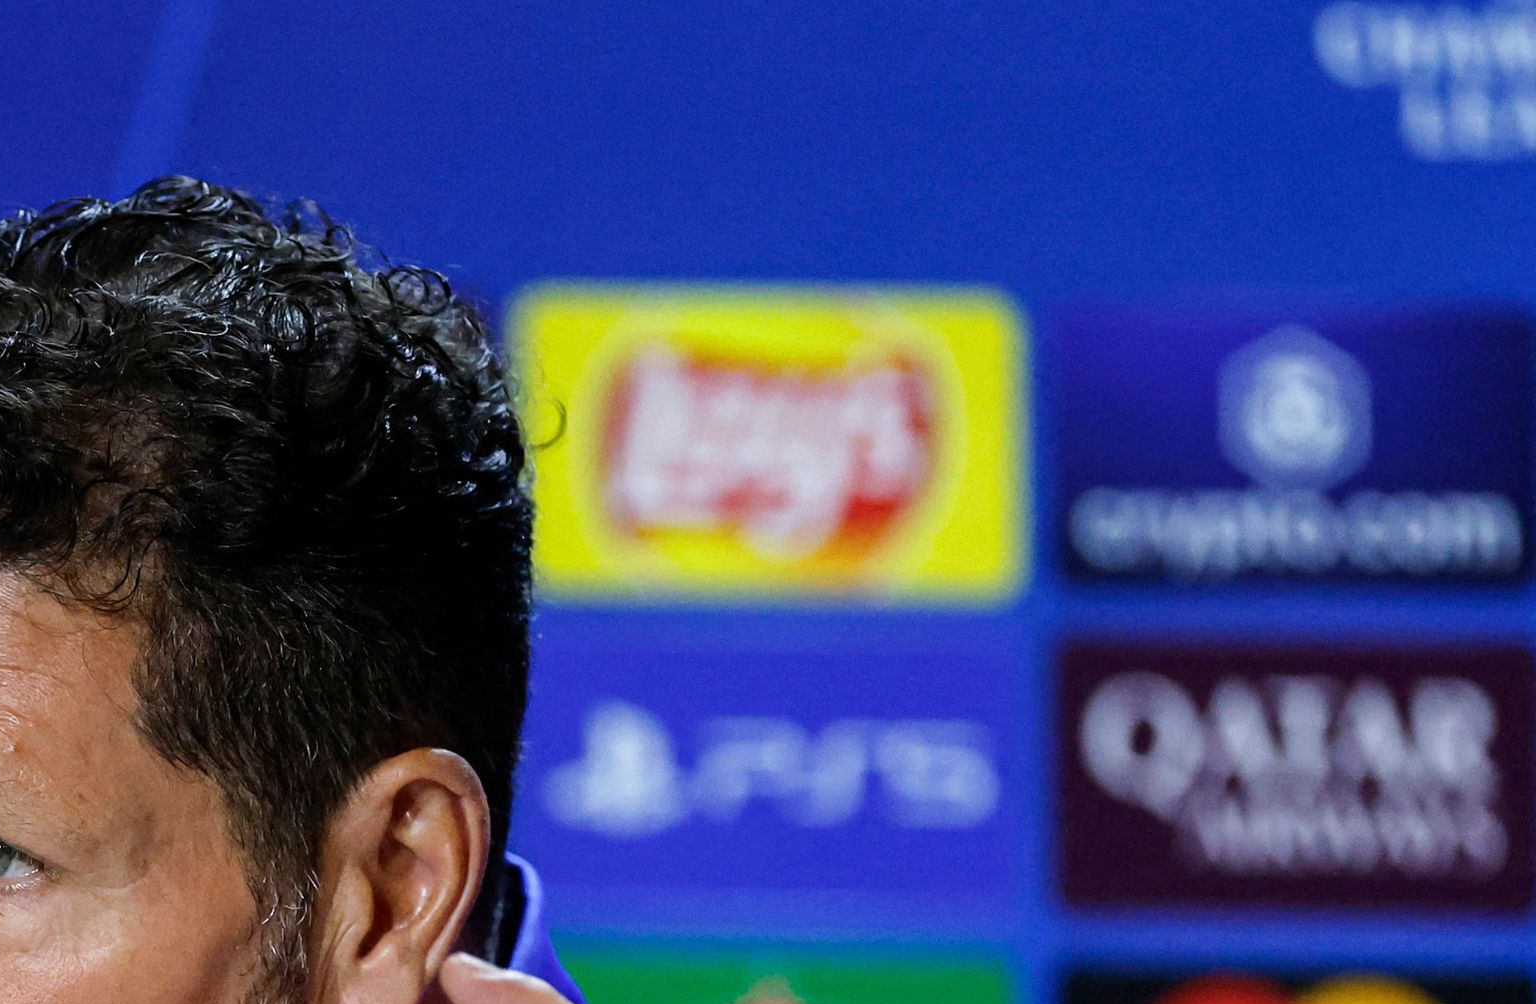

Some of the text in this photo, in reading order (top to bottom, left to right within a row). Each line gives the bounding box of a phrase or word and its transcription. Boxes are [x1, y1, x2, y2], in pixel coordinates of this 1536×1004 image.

[1072, 488, 1518, 580] crypto.com
[1082, 673, 1498, 812] QATAR
[1188, 798, 1506, 876] AIRWAYS
